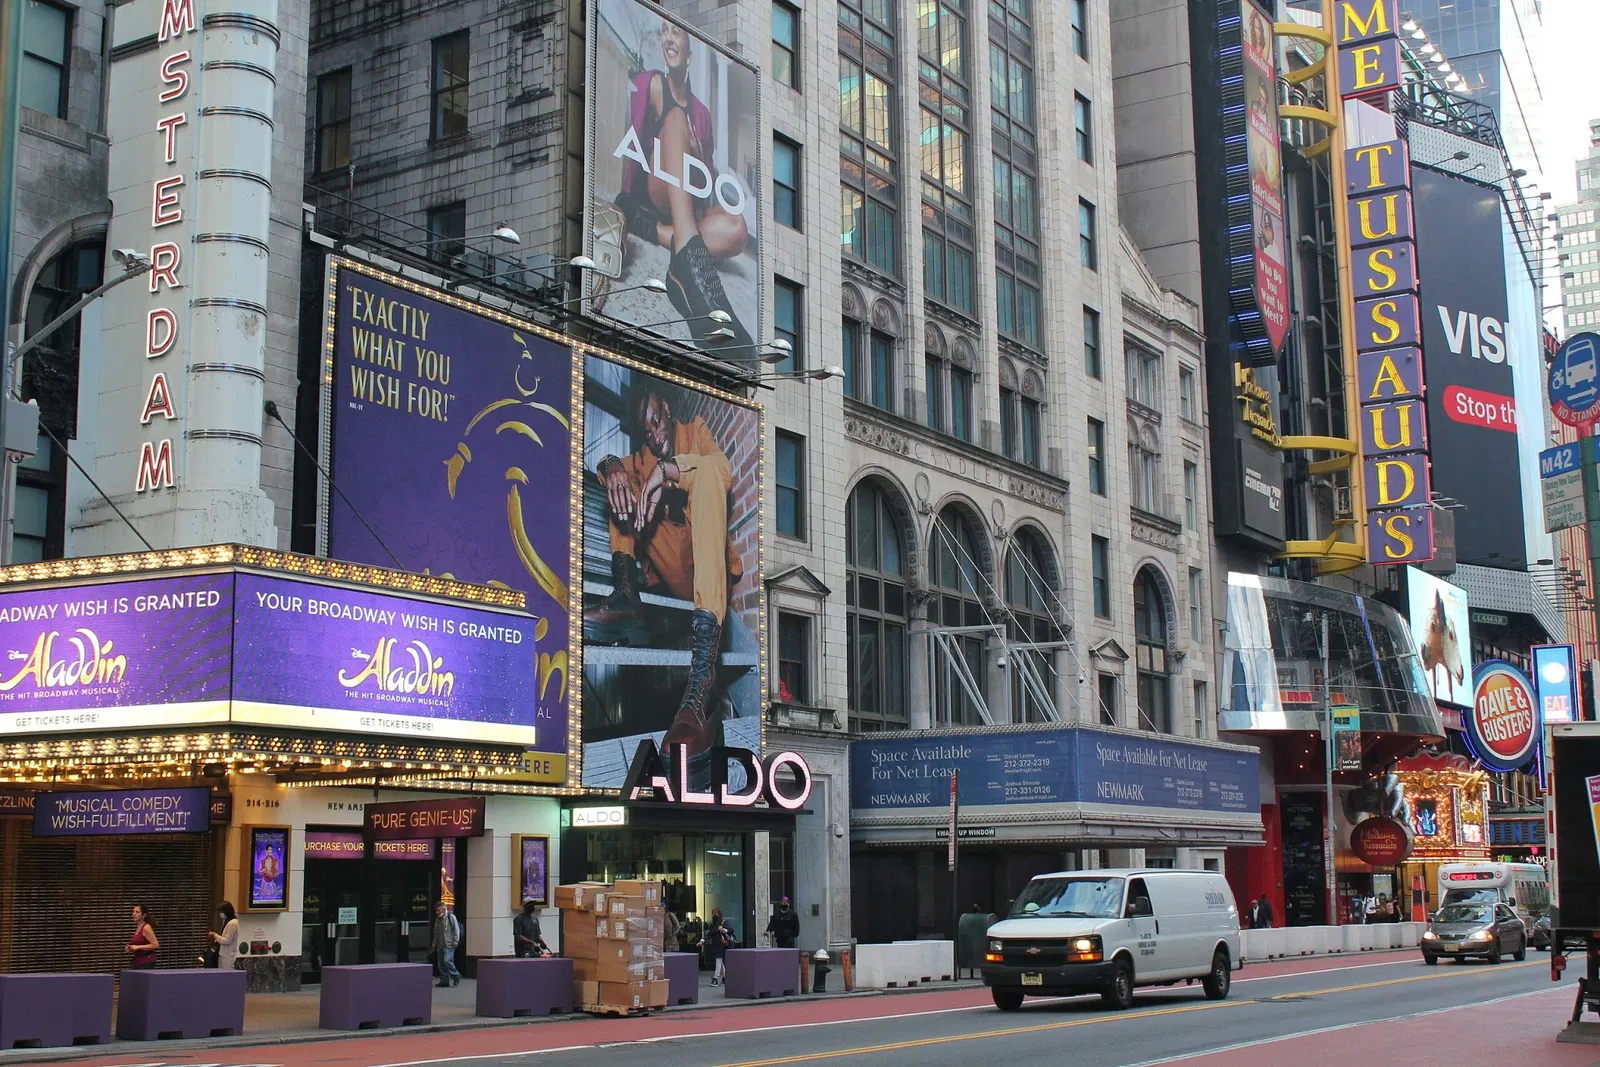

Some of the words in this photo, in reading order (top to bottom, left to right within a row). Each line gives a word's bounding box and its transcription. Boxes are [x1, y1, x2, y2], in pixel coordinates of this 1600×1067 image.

[613, 125, 746, 216] ALDO
[1252, 179, 1281, 215] Entertaining
[135, 0, 197, 492] MSTERDAM
[1265, 277, 1277, 295] You
[346, 285, 430, 341] “EXACTLY
[1263, 303, 1284, 327] Meet?
[352, 326, 405, 372] WHAT
[415, 346, 450, 385] YOU
[351, 365, 399, 410] WISH
[407, 382, 456, 423] FOR!”
[1456, 392, 1497, 425] Stop
[1557, 405, 1569, 420] NO
[1570, 399, 1600, 422] STANDI
[914, 441, 1006, 490] CANDLER
[1542, 449, 1573, 474] M42
[1546, 502, 1574, 517] Suburban
[1568, 511, 1584, 523] Corp.
[65, 597, 109, 618] WISH
[113, 597, 129, 614] IS
[134, 590, 221, 613] GRANTED
[256, 591, 303, 612] YOUR
[308, 599, 397, 626] BROADWAY
[401, 613, 438, 632] WISH
[443, 619, 455, 634] IS
[459, 623, 523, 645] GRANTED
[1476, 614, 1503, 624] LAMAR
[0, 627, 128, 691] Aladdin
[337, 636, 456, 698] Aladdin
[0, 692, 16, 701] THE
[18, 692, 32, 700] HIT
[34, 689, 79, 699] BROADWAY
[81, 686, 118, 695] MUSICAL
[345, 690, 359, 699] THE
[361, 692, 374, 700] HIT
[376, 693, 416, 704] BROADWAY
[418, 697, 449, 708] MUSICAL
[1479, 686, 1517, 721] DAVE
[1516, 686, 1528, 709] &
[16, 717, 33, 728] GET
[35, 715, 71, 726] TICKETS
[74, 713, 100, 724] HERE!
[360, 716, 376, 727] GET
[378, 718, 410, 730] TICKETS
[412, 720, 434, 732] HERE!
[1483, 709, 1531, 743] BUSTER'S
[871, 749, 908, 766] Space
[912, 745, 972, 762] Available
[1004, 758, 1050, 768] 212-372-2319
[1096, 742, 1121, 767] Space
[1122, 746, 1158, 768] Available
[1159, 751, 1172, 768] For
[1173, 752, 1187, 770] Net
[1188, 758, 1208, 772] Lease
[524, 759, 550, 775] ERE
[620, 738, 812, 811] ALDO
[871, 767, 893, 781] For
[896, 767, 919, 780] Net
[924, 765, 961, 779] Lease
[871, 793, 931, 805] NEWMARK
[1005, 786, 1051, 795] 212-331-0126
[1097, 781, 1145, 801] NEWMARK
[55, 797, 118, 814] “MUSICAL
[122, 795, 182, 811] COMEDY
[246, 799, 280, 808] 214-216
[327, 802, 344, 811] NEW
[51, 811, 191, 829] WISH-FULFILLMENT!”
[371, 812, 405, 829] “PURE
[410, 808, 477, 828] GENIE-US!”
[575, 810, 622, 824] ALDO
[958, 829, 967, 837] UP
[968, 828, 995, 837] WINDOW
[1360, 827, 1397, 841] Madame
[343, 842, 364, 852] YOUR
[375, 843, 405, 853] TICKETS
[407, 843, 428, 853] HERE!
[1360, 838, 1398, 850] Tussauds
